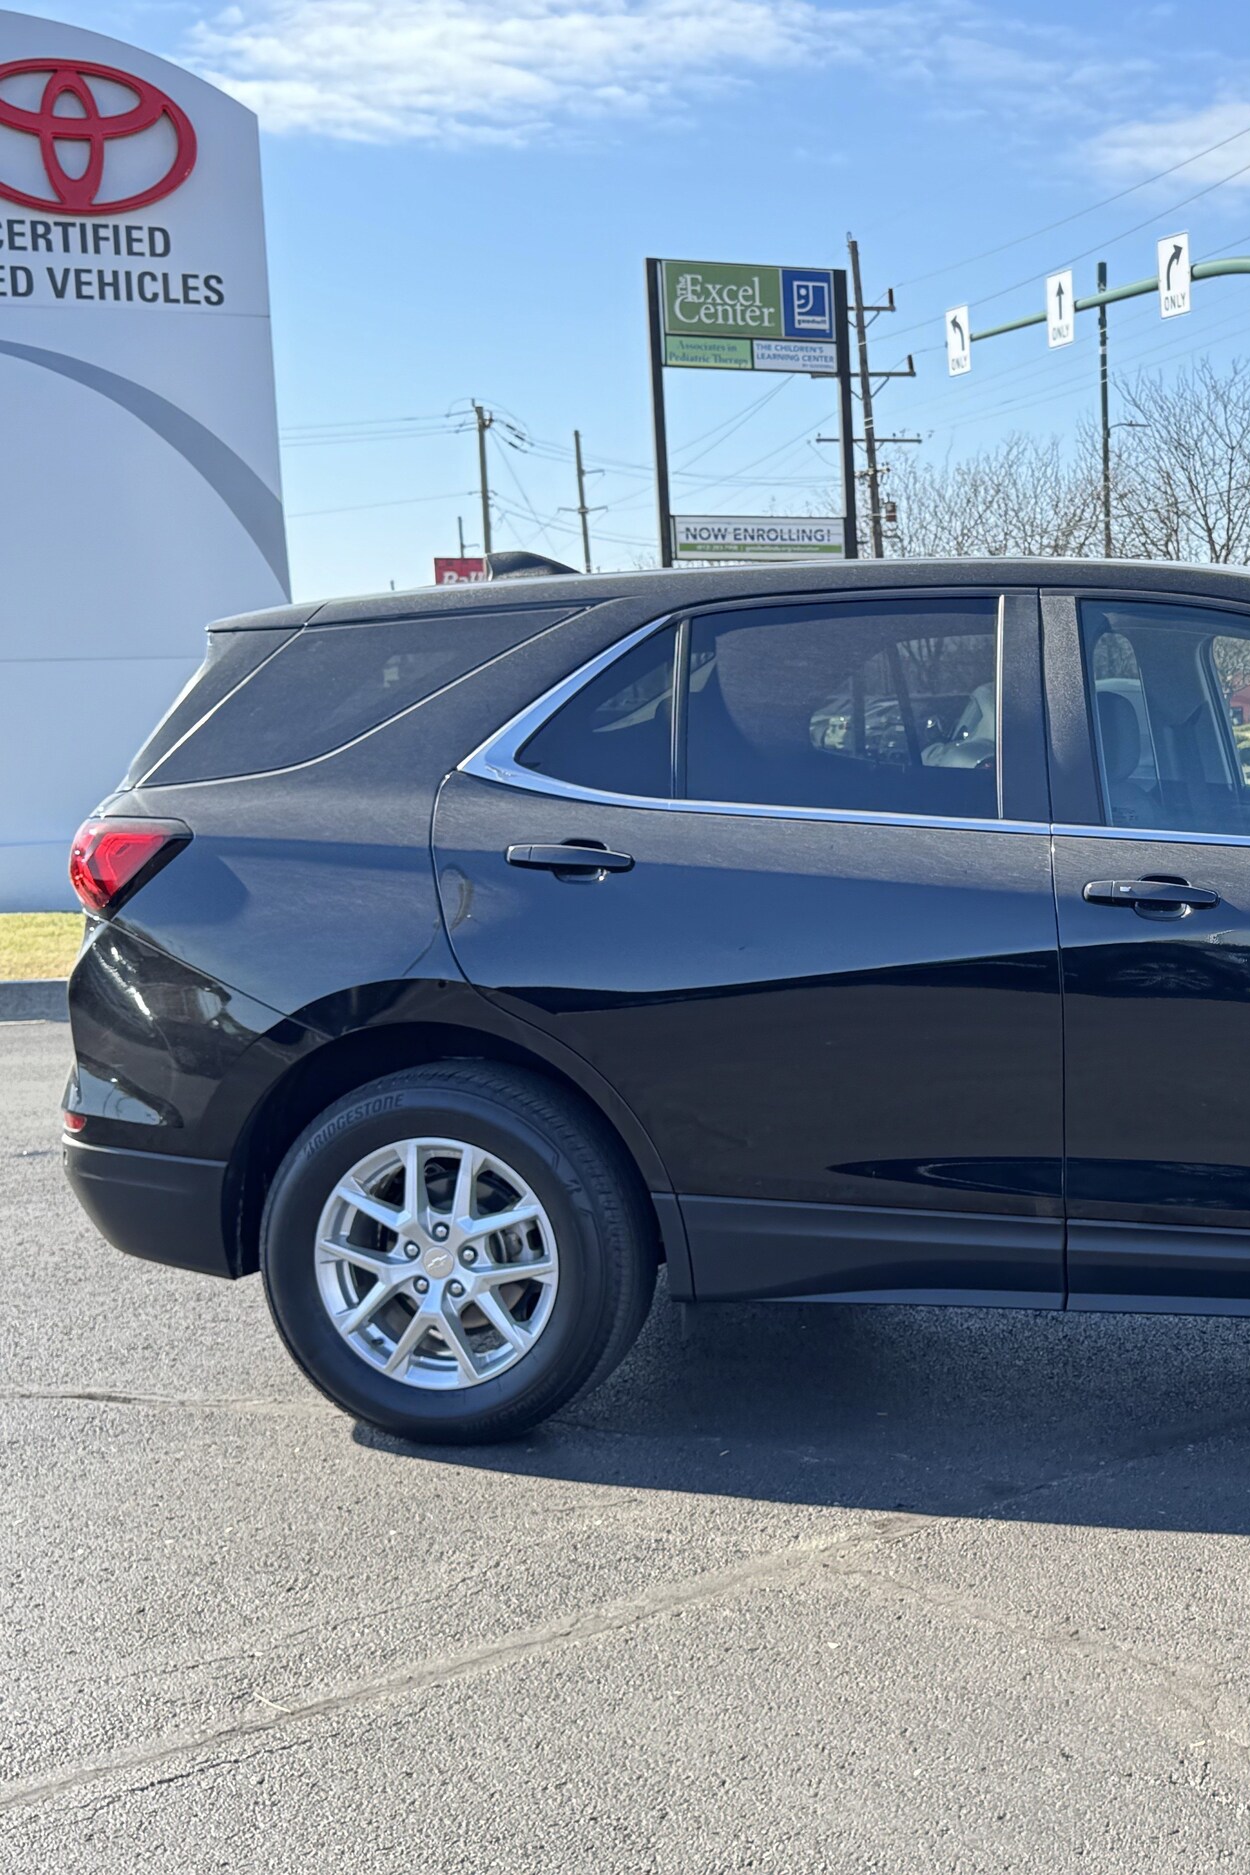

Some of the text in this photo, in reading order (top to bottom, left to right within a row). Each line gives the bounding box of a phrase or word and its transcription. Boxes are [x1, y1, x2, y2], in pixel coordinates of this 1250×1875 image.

[0, 219, 171, 258] ERTIFIED
[46, 267, 225, 306] VEHICLES
[676, 276, 687, 297] The
[684, 273, 762, 306] Excel
[674, 295, 775, 327] Center
[1164, 292, 1186, 312] ONLY
[1052, 326, 1070, 341] ONLY
[755, 343, 824, 353] THE CHILDREN'S
[756, 353, 834, 363] LEARNING CENTER
[669, 352, 748, 368] Pediatric Therapy
[951, 356, 968, 371] ONLY
[685, 527, 831, 542] NOW ENROLLING!
[303, 1094, 404, 1160] BRIDGESTONE
